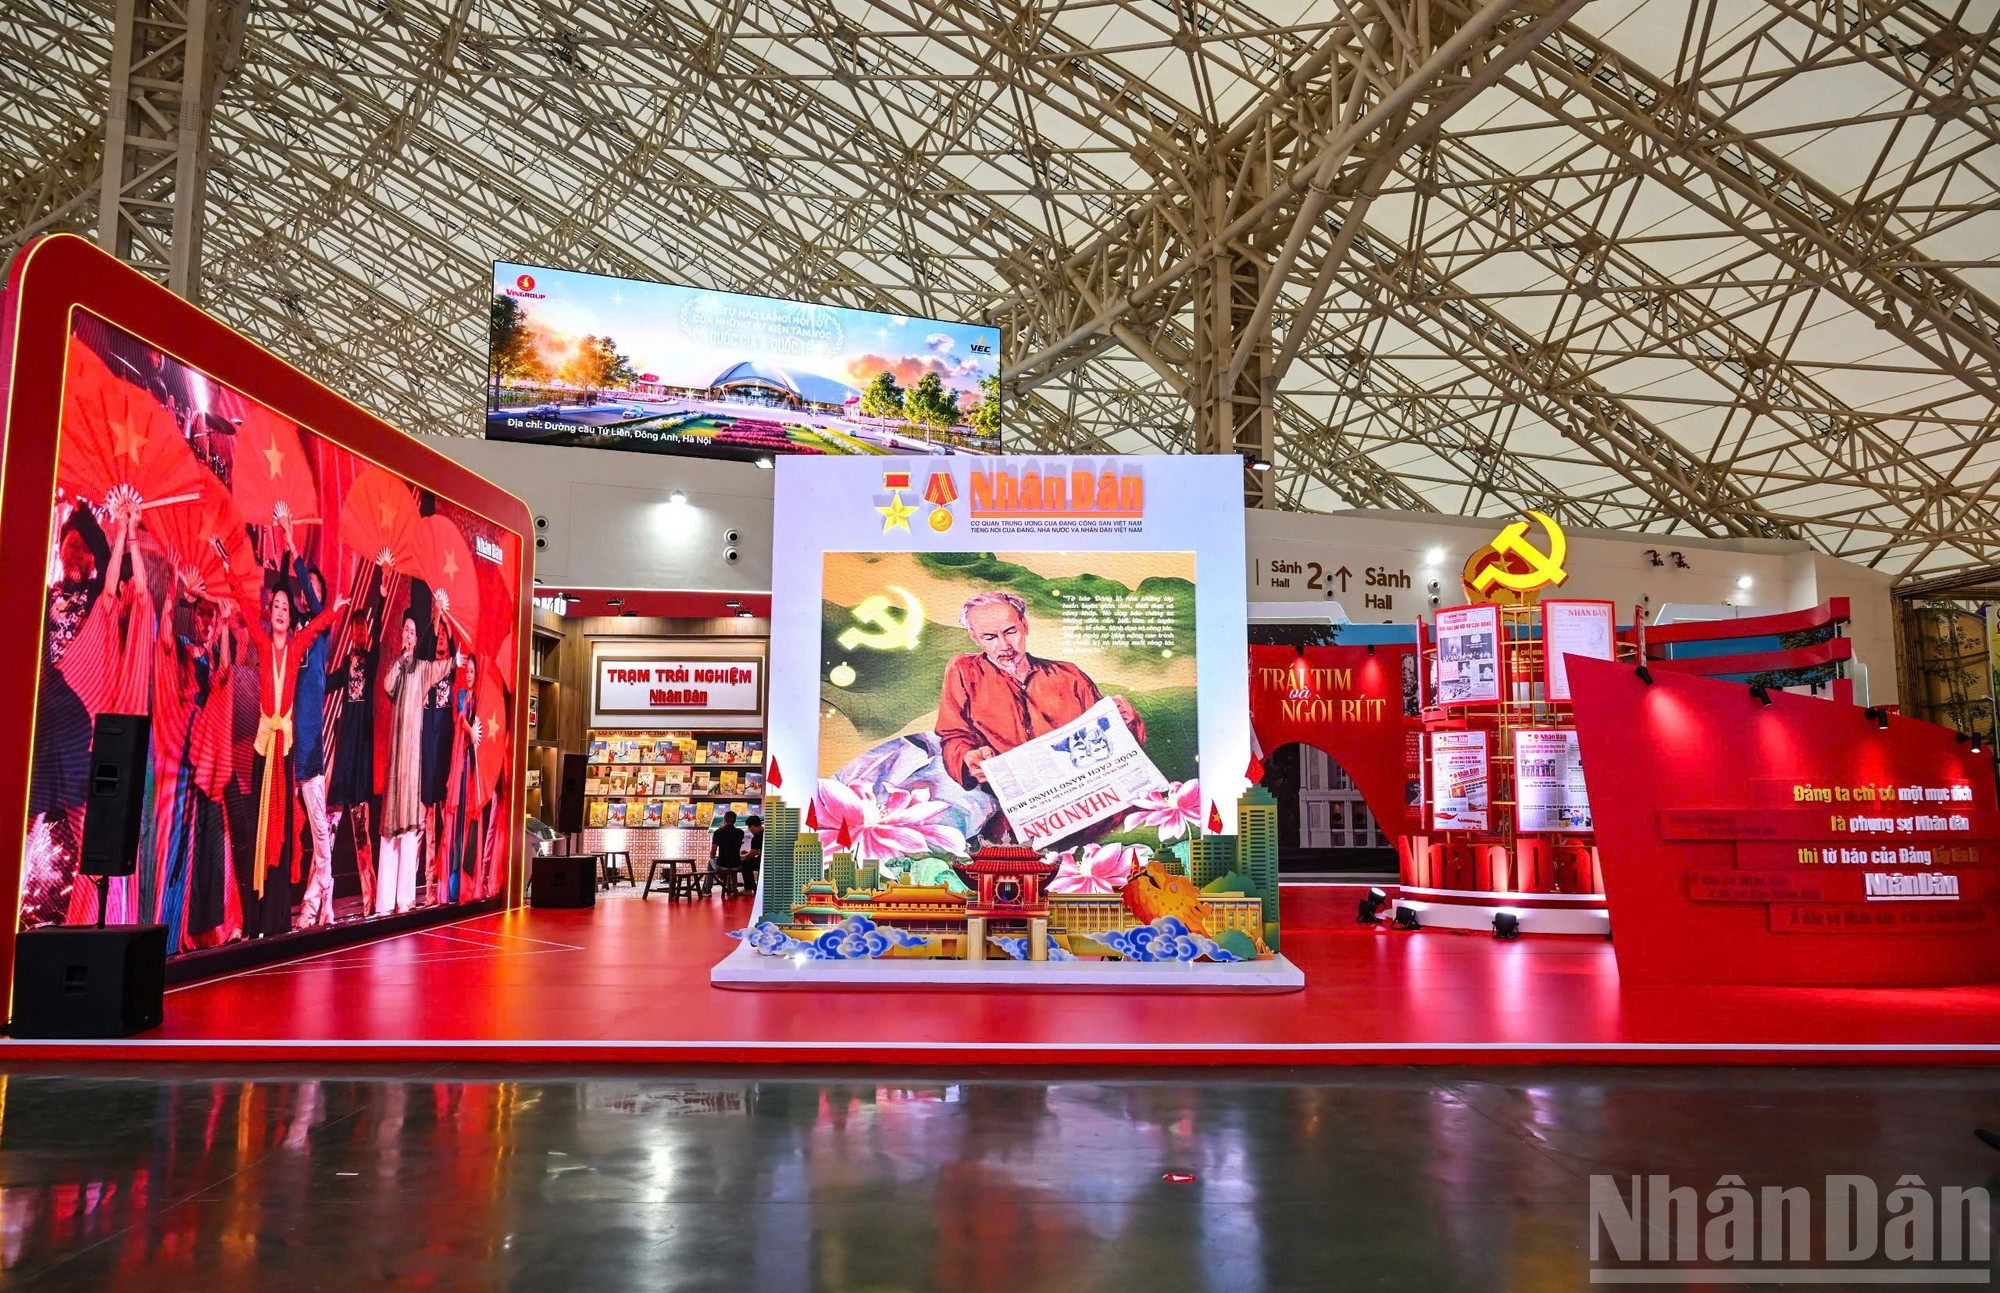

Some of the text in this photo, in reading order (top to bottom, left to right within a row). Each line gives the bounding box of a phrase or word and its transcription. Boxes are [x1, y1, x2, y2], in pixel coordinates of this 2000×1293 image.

[506, 288, 546, 299] VINGROUP
[970, 344, 991, 353] VEC
[507, 418, 523, 428] Địa
[544, 421, 576, 434] Đường
[578, 424, 595, 434] cầu
[634, 430, 658, 442] Đông
[660, 433, 681, 443] Anh,
[682, 434, 694, 443] Hà
[696, 436, 711, 446] Nội
[970, 471, 1143, 510] Nhân Dân
[476, 535, 492, 557] Nhân
[1271, 560, 1323, 590] Sảnh 2
[1271, 577, 1290, 588] Hall
[1365, 566, 1411, 589] Sảnh
[1365, 593, 1393, 610] Hall
[607, 664, 752, 686] TRẠM TRẢI NGHIỆM
[1258, 663, 1352, 692] TRÁI TIM
[650, 689, 708, 703] Nhân Dân
[1288, 686, 1312, 699] và
[1281, 694, 1386, 722] NGÒI BÚT
[1793, 783, 1832, 803] Đảng
[1834, 786, 1850, 802] ta
[1852, 783, 1876, 801] chỉ
[1879, 785, 1896, 801] có
[1897, 785, 1924, 804] một
[1924, 786, 1950, 804] mục
[1831, 815, 1970, 834] là phụng sự Nhân dân
[1798, 847, 1819, 864] thì
[1821, 848, 1838, 864] tờ
[1840, 847, 1868, 864] báo
[1870, 845, 1897, 864] của
[1898, 846, 1932, 866] Đảng
[1865, 872, 1960, 896] Nhân Dân
